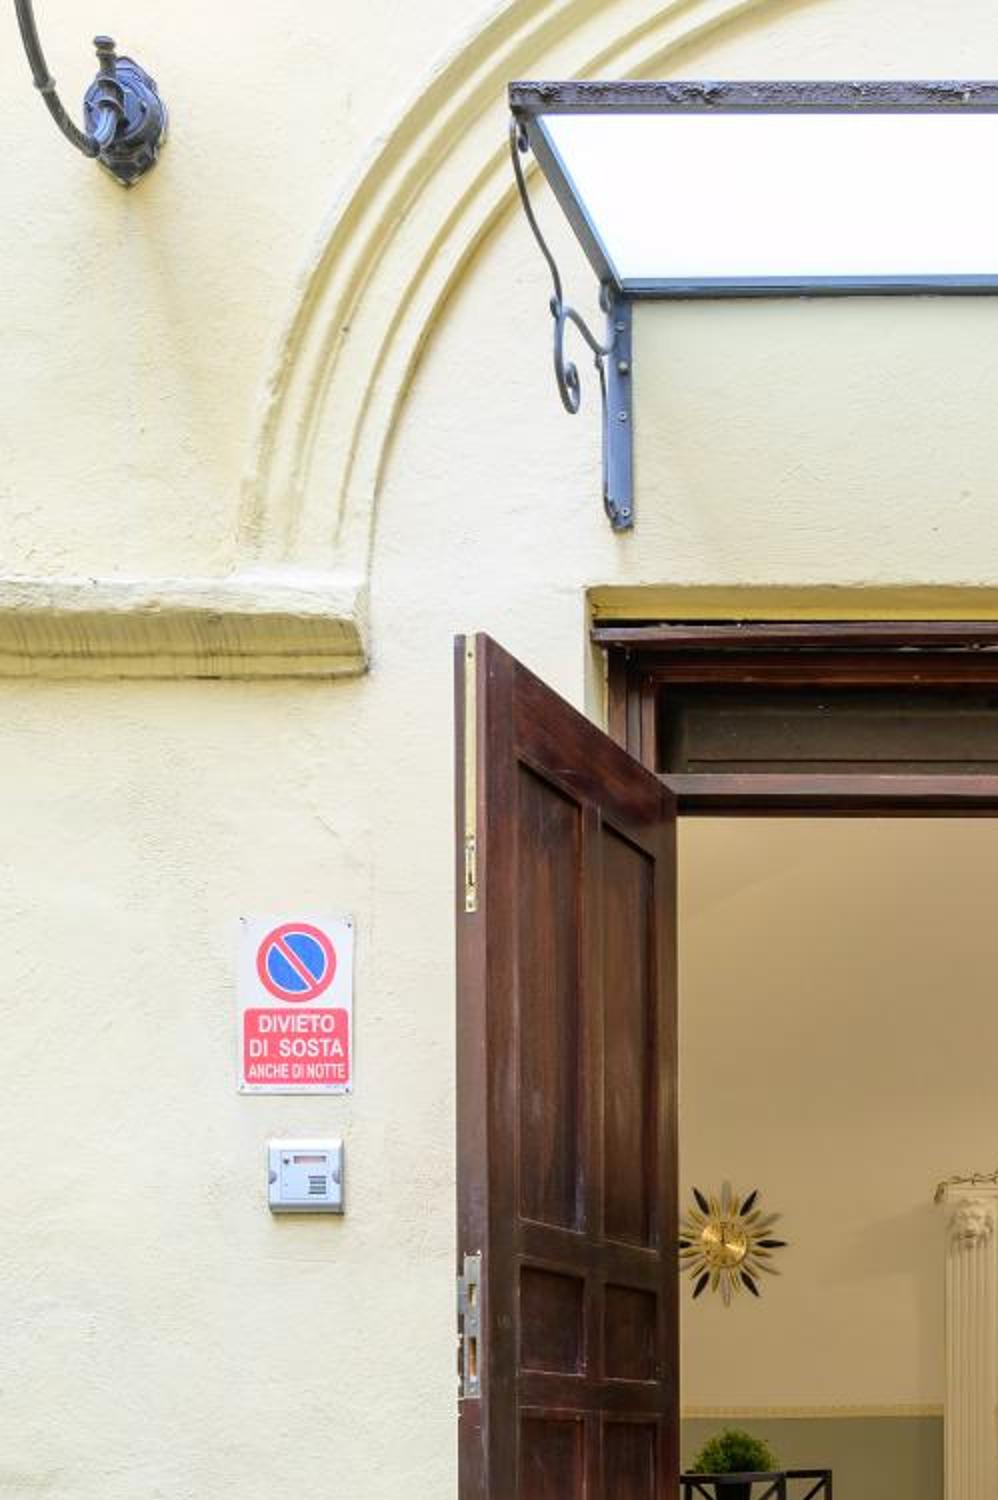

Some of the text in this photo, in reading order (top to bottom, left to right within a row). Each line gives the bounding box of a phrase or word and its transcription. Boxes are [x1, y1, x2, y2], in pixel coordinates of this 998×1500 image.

[259, 1015, 335, 1033] DIVIETO
[249, 1039, 344, 1057] DI SOSTA
[248, 1063, 346, 1079] ANCHE DI NOTTE
